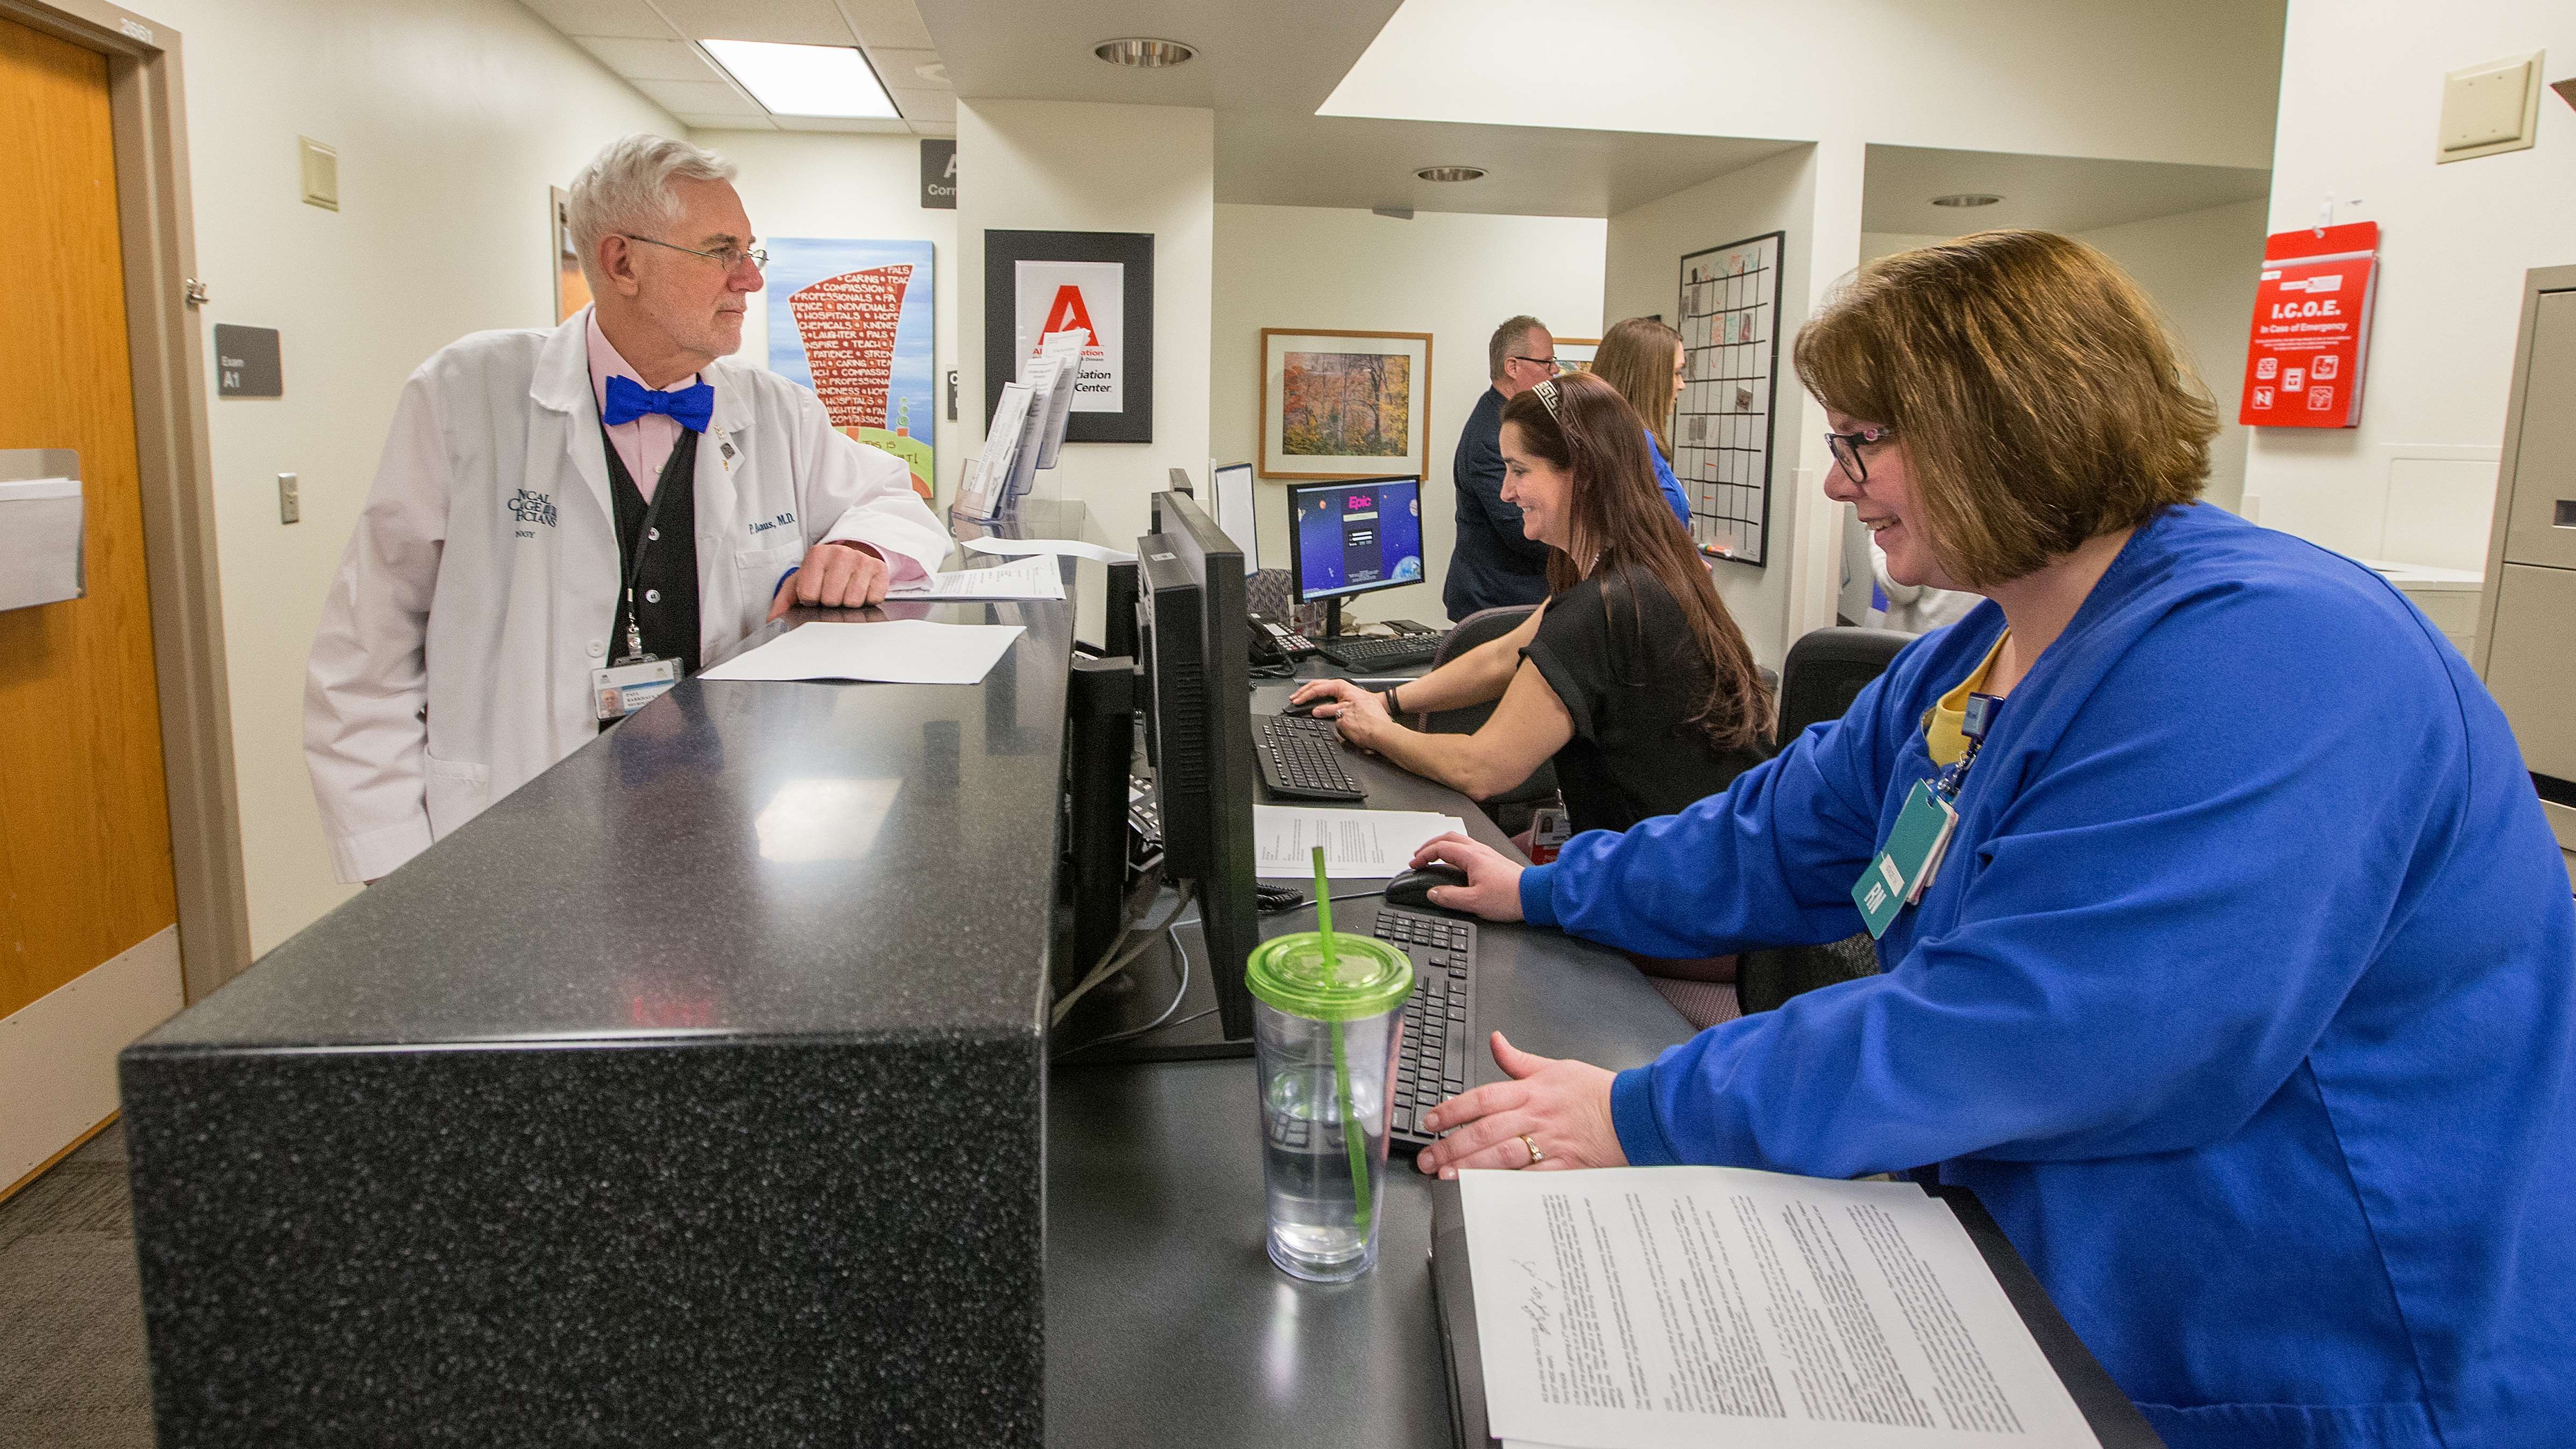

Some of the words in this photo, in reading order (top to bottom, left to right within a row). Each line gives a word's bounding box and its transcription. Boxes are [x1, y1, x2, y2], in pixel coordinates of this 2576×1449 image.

[888, 266, 910, 274] PALS
[823, 283, 885, 293] COMPASSION
[794, 292, 873, 302] PROFESSIONALS
[883, 295, 896, 303] PA
[792, 303, 823, 311] TIENCE
[837, 303, 896, 312] INDIVIDUALS
[2272, 299, 2341, 319] I.C.O.E.
[804, 312, 860, 320] HOSPITALS
[799, 321, 852, 330] CHEMICALS
[2300, 323, 2349, 333] Emergency
[813, 331, 857, 339] LAUGHTER
[814, 350, 853, 358] PATIENCE
[836, 360, 867, 368] CARING
[223, 371, 240, 387] A1
[1075, 383, 1111, 392] Center
[1349, 494, 1372, 510] Epic
[1864, 881, 1887, 915] RN
